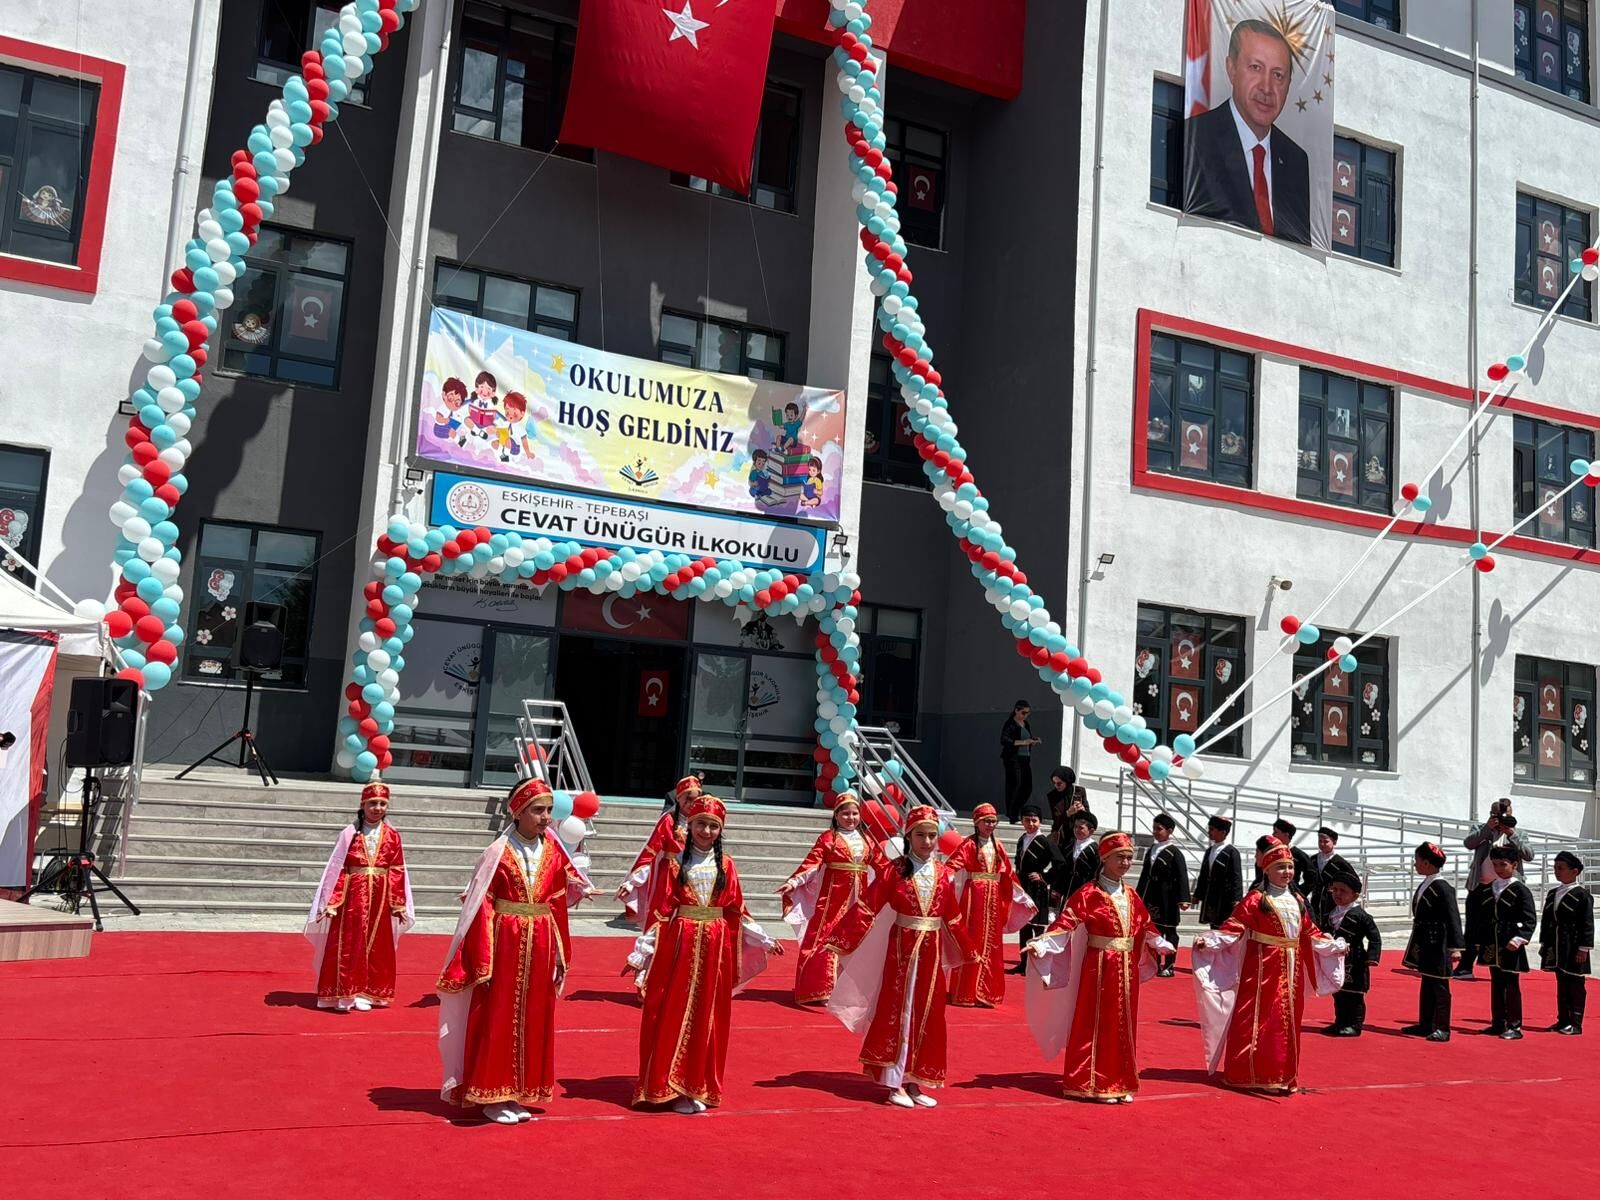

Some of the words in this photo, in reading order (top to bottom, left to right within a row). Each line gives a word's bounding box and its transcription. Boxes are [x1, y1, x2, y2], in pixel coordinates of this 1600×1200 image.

[569, 363, 724, 414] OKULUMUZA
[558, 400, 610, 437] HOŞ
[618, 414, 734, 454] GELDİNİZ
[502, 490, 574, 510] ESKİŞEHİR
[585, 502, 649, 521] TEPEBAŞI
[500, 508, 578, 533] CEVAT
[583, 518, 686, 549] ÜNÜGÜR
[691, 530, 799, 563] İLKOKULU
[420, 582, 455, 591] ocukların
[456, 585, 479, 594] büyük
[479, 588, 511, 597] hayalleri
[466, 577, 478, 585] için
[479, 578, 501, 587] büyük
